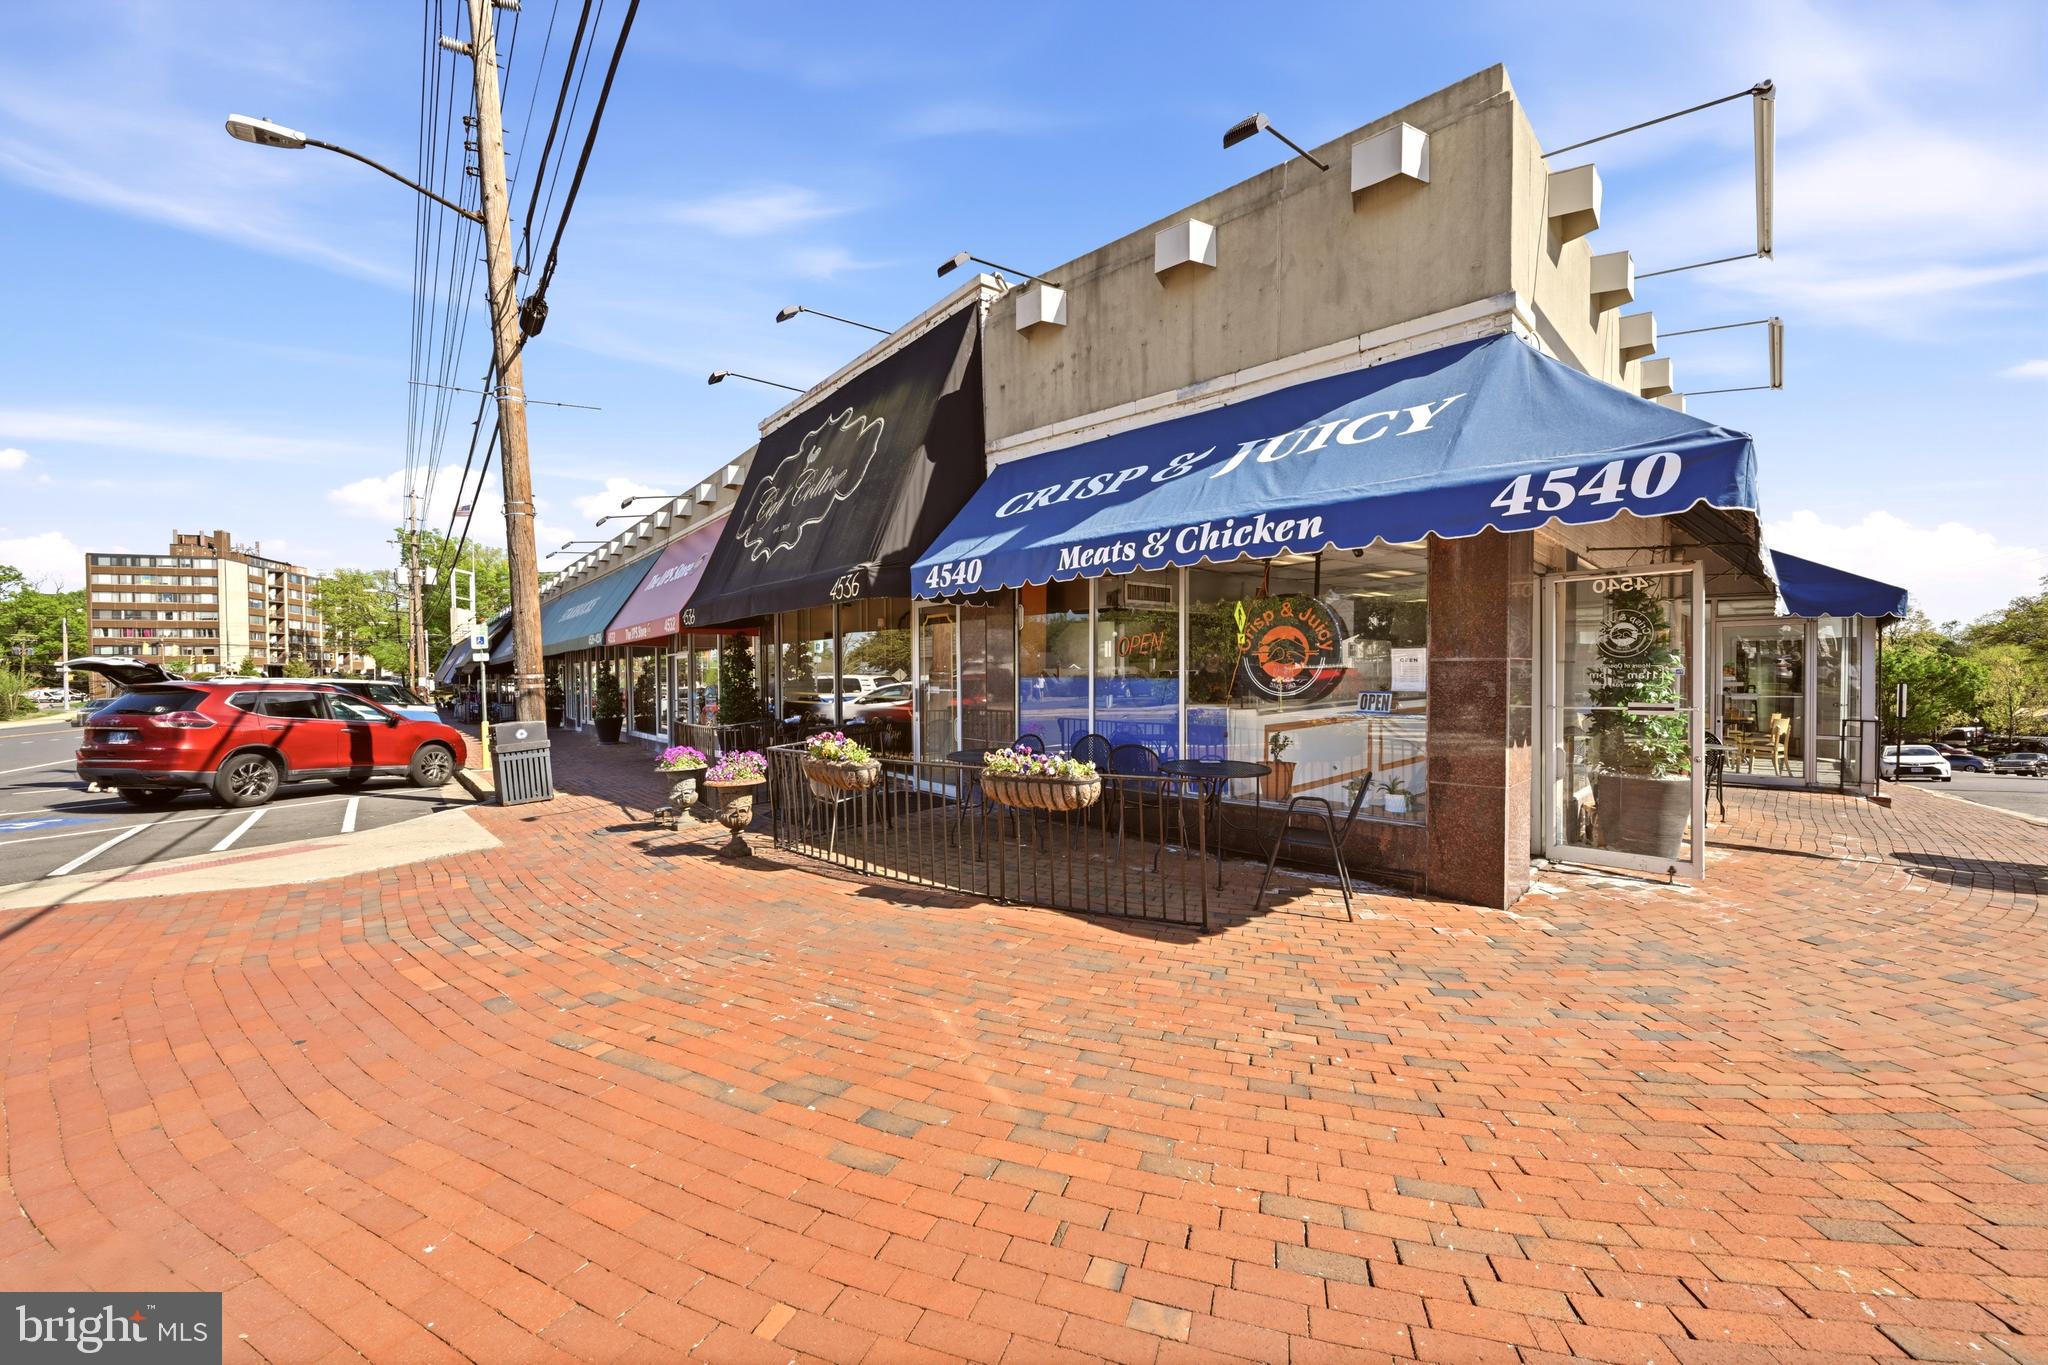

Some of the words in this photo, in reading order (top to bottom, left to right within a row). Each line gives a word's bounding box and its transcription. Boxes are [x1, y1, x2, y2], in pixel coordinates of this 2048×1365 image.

[995, 466, 1149, 518] CRISP
[1151, 446, 1216, 482] &
[1209, 392, 1467, 479] JUICY
[1490, 452, 1682, 516] 4540
[1057, 540, 1136, 571] Meats
[1142, 529, 1171, 558] &
[1175, 515, 1324, 554] Chicken
[829, 572, 860, 600] 4536
[925, 558, 982, 589] 4540
[682, 607, 696, 626] 4536
[1237, 609, 1275, 652] Crisp
[1280, 602, 1294, 617] &
[1298, 607, 1334, 651] Juicy
[1117, 631, 1164, 658] OPEN
[1359, 693, 1390, 711] OPEN
